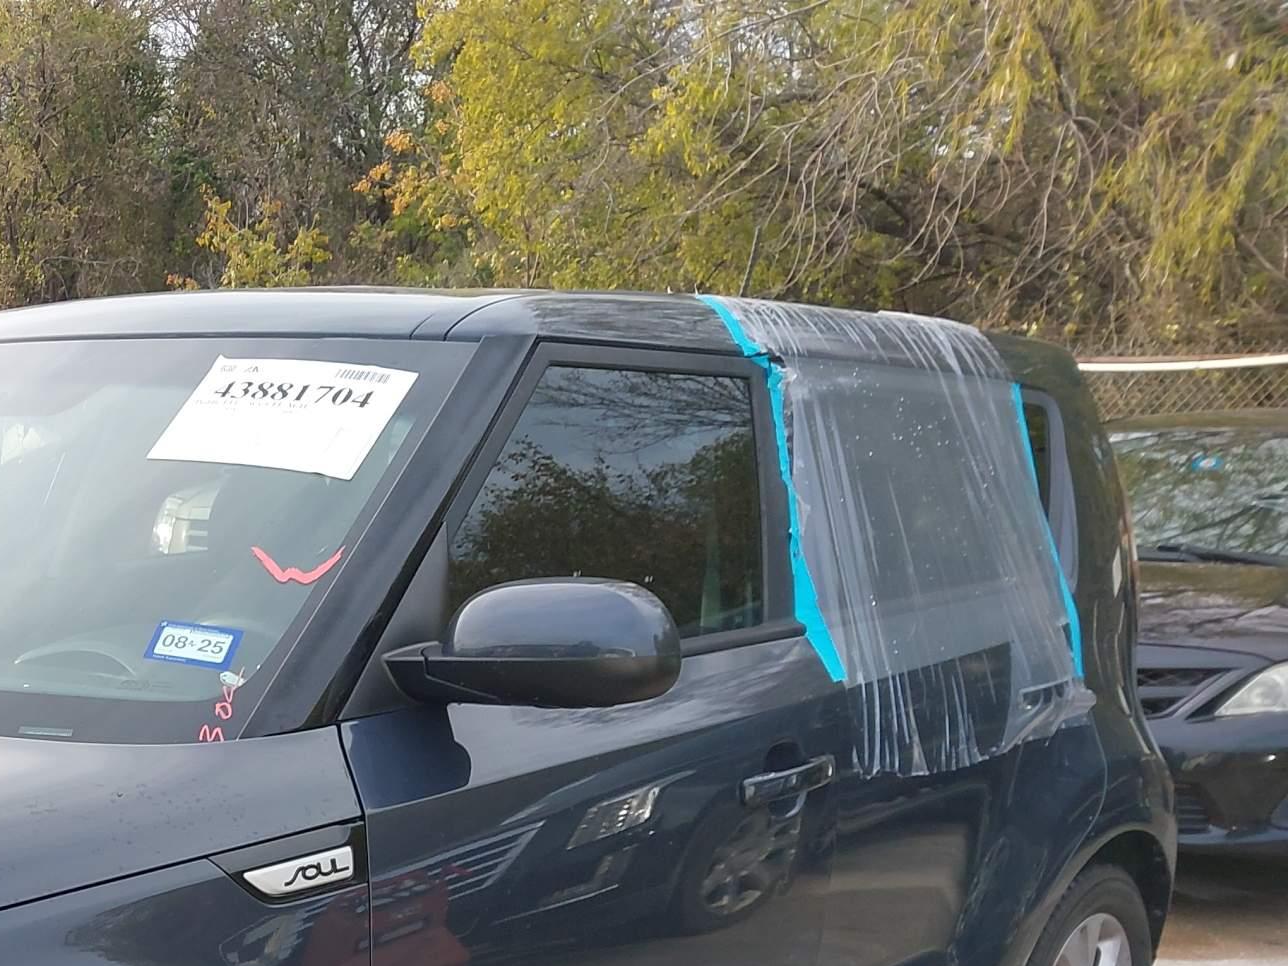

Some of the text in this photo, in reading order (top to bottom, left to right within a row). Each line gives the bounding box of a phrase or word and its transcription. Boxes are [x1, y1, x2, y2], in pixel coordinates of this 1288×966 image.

[214, 381, 375, 408] 43881704
[162, 634, 225, 655] 08 25
[284, 858, 350, 887] SOUL
